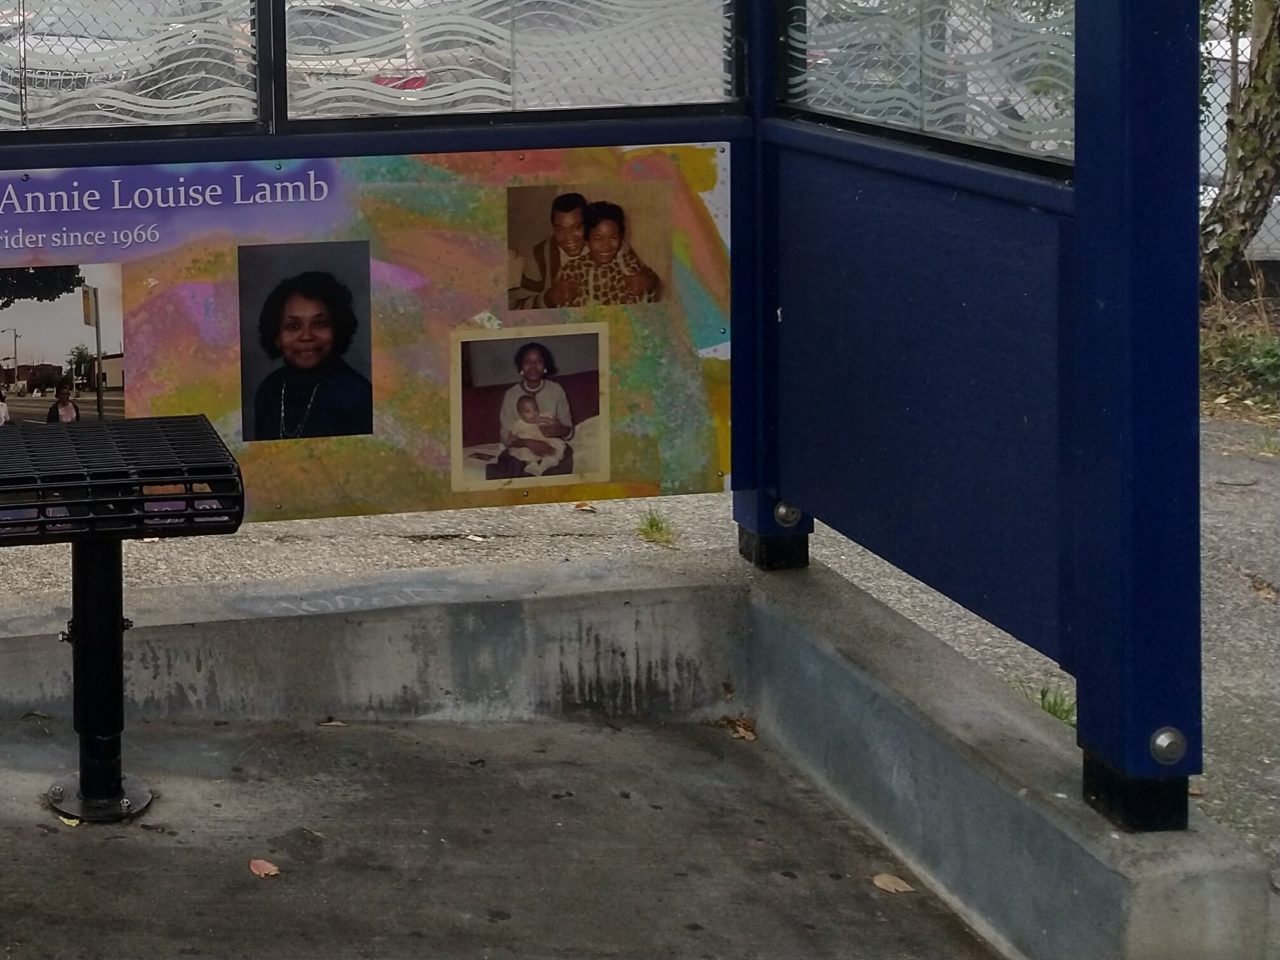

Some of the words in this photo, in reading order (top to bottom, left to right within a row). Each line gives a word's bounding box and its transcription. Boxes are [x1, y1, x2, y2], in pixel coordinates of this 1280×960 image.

[111, 177, 222, 210] Louise
[232, 170, 329, 205] Lamb
[51, 227, 106, 247] since
[112, 223, 160, 248] 1966
